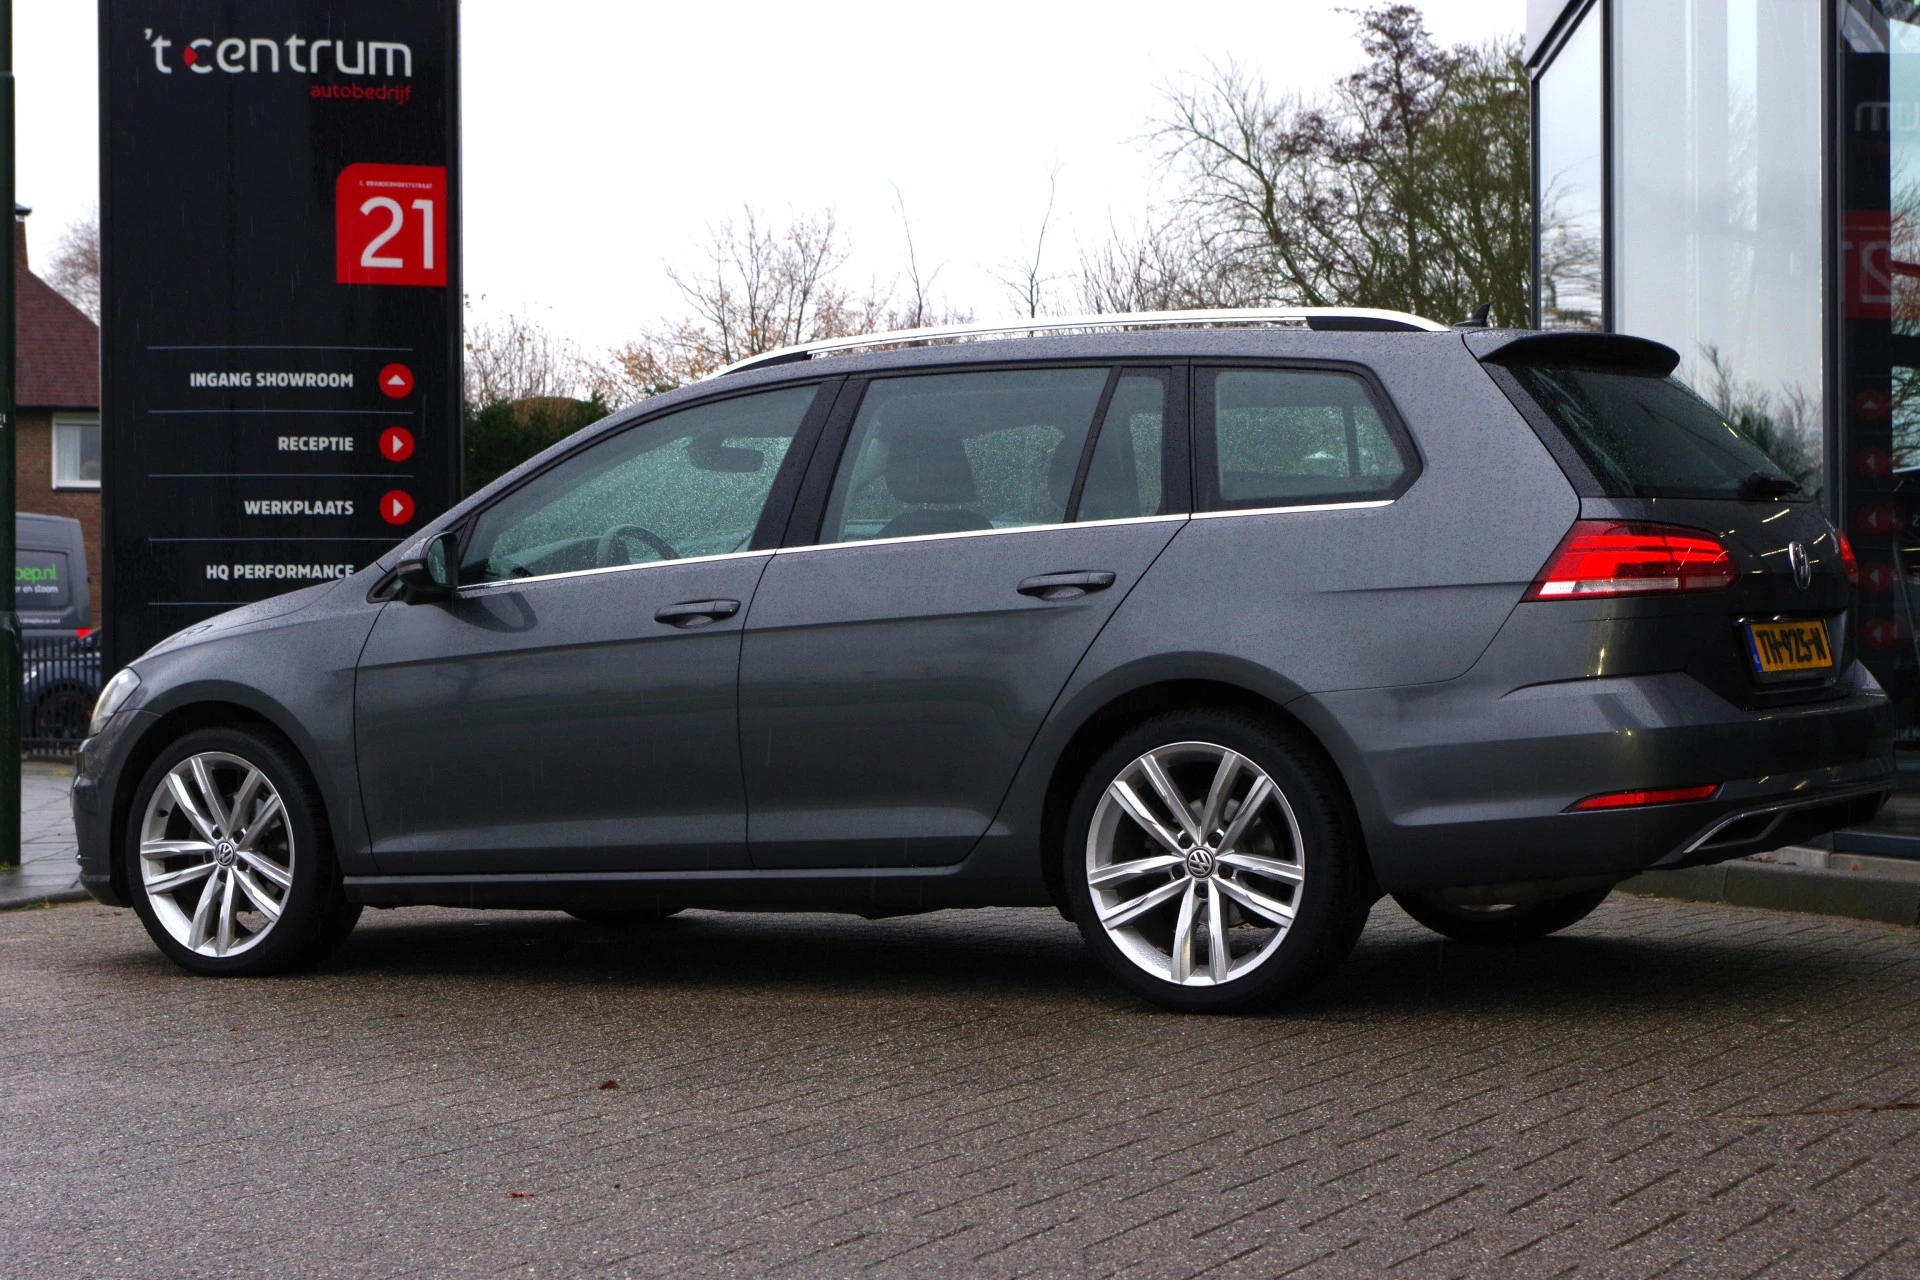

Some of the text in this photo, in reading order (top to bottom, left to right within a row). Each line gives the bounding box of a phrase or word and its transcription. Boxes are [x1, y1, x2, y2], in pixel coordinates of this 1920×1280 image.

[183, 33, 412, 77] centrum
[310, 83, 412, 105] autobedrijf
[359, 196, 434, 270] 21
[190, 372, 354, 388] INGANG SHOWROOM
[278, 436, 354, 451] RECEPTIE
[244, 500, 354, 515] WERKPLAATS
[16, 562, 57, 584] oep.nl
[206, 564, 354, 581] HQ PERFORMANCE
[1755, 626, 1828, 666] TH-925-N
